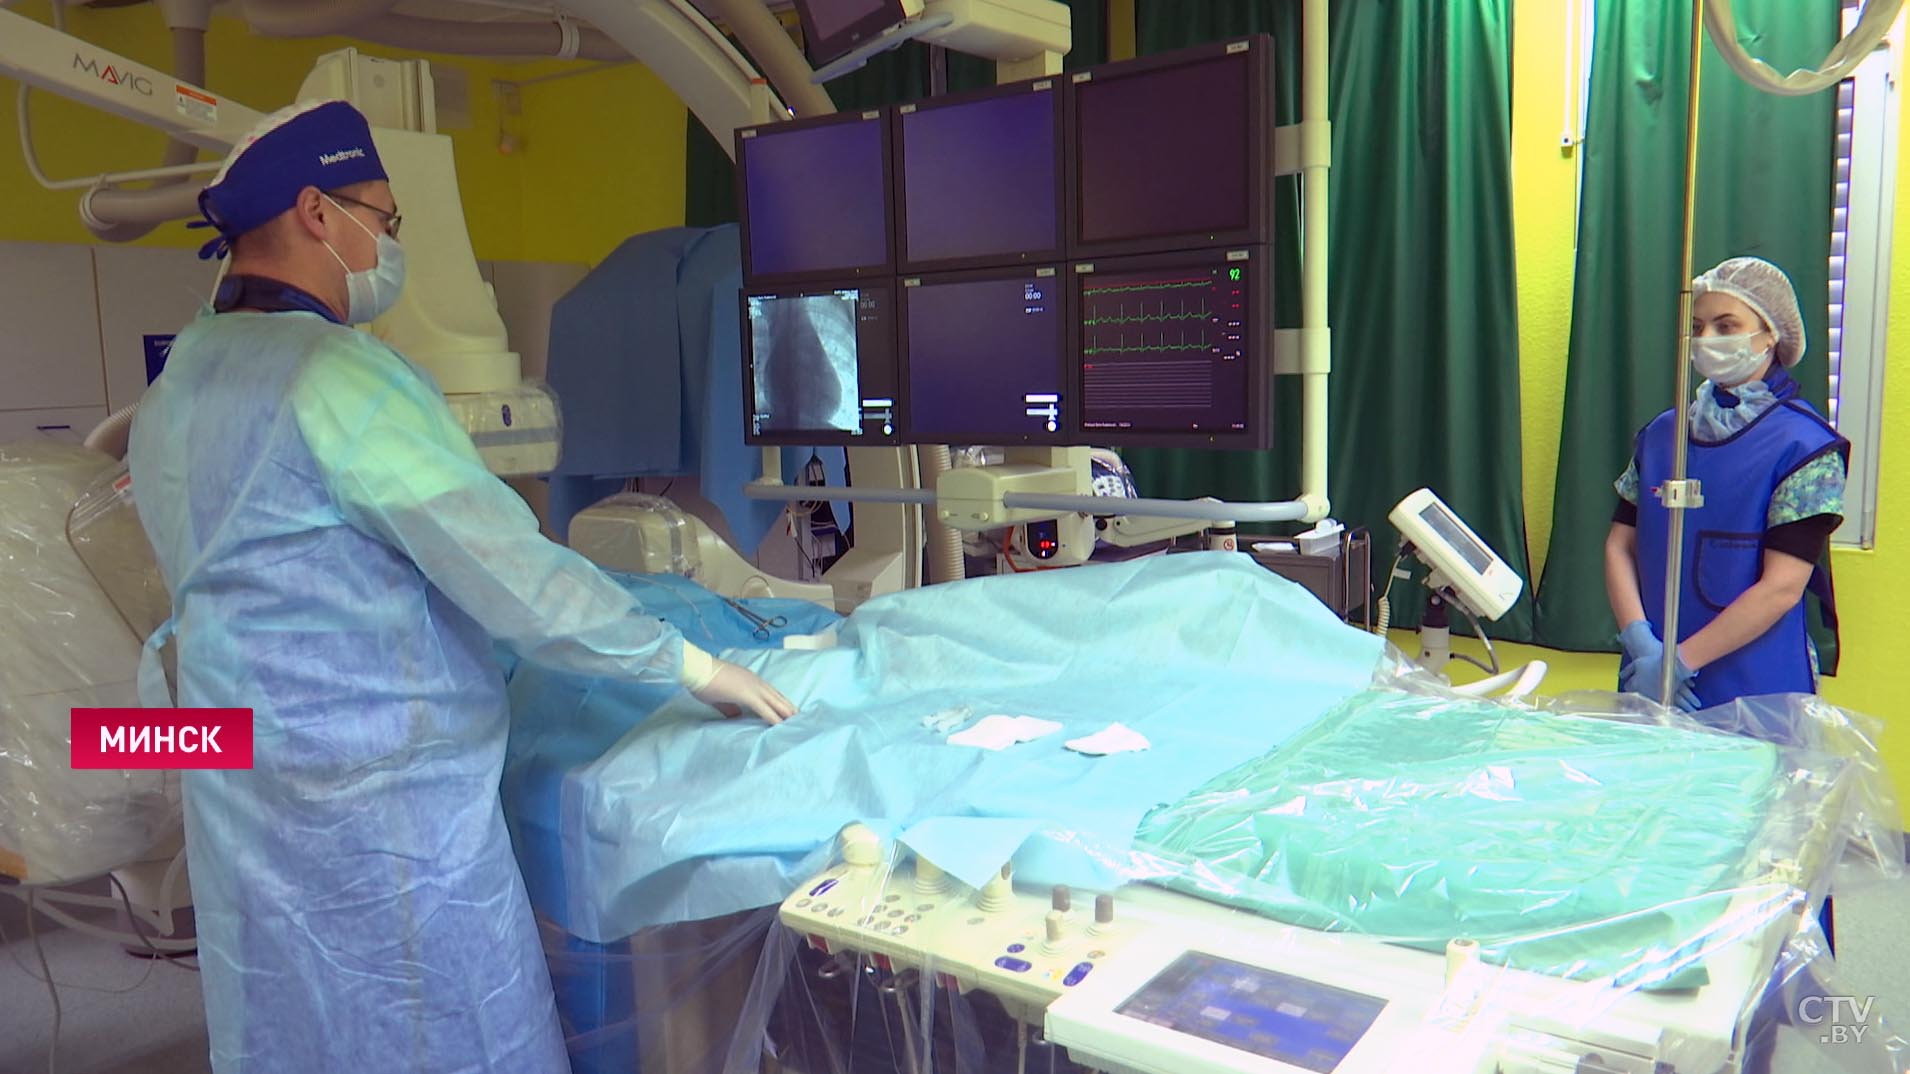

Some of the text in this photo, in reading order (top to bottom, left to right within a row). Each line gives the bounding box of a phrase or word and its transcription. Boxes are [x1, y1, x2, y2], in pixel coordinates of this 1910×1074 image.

[73, 53, 153, 96] MAVIG
[319, 147, 366, 167] Medtronic
[1229, 268, 1241, 281] 92
[1024, 291, 1042, 300] 0000
